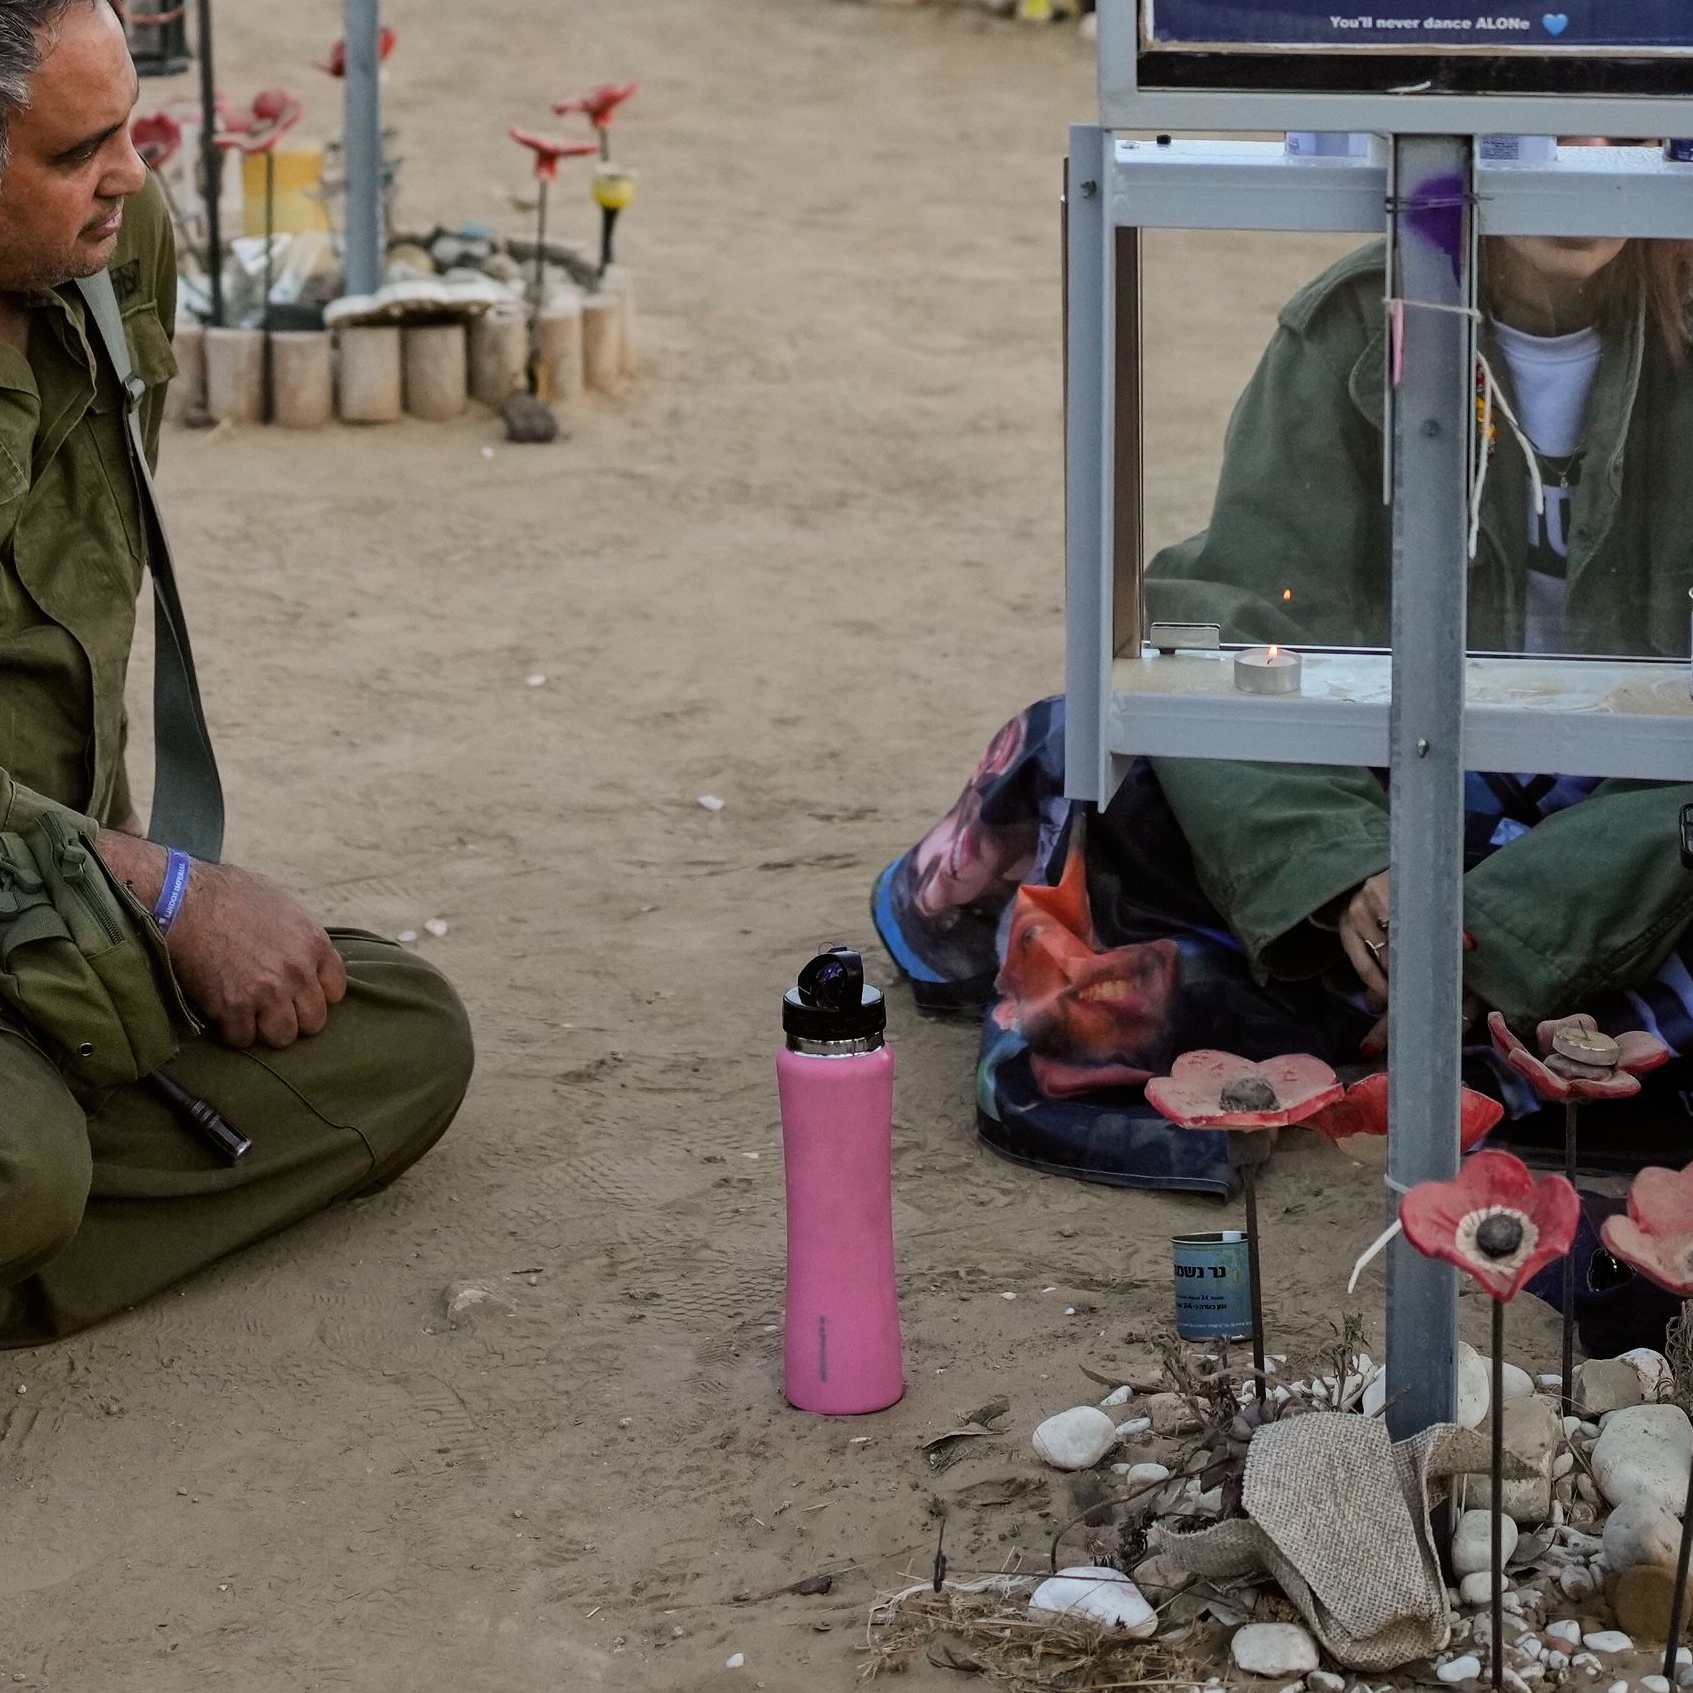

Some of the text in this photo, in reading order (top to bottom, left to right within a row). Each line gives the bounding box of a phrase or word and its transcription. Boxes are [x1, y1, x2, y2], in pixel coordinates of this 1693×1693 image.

[1328, 15, 1532, 30] You'll never dance ALONe
[1174, 1264, 1227, 1279] נר נשמ
